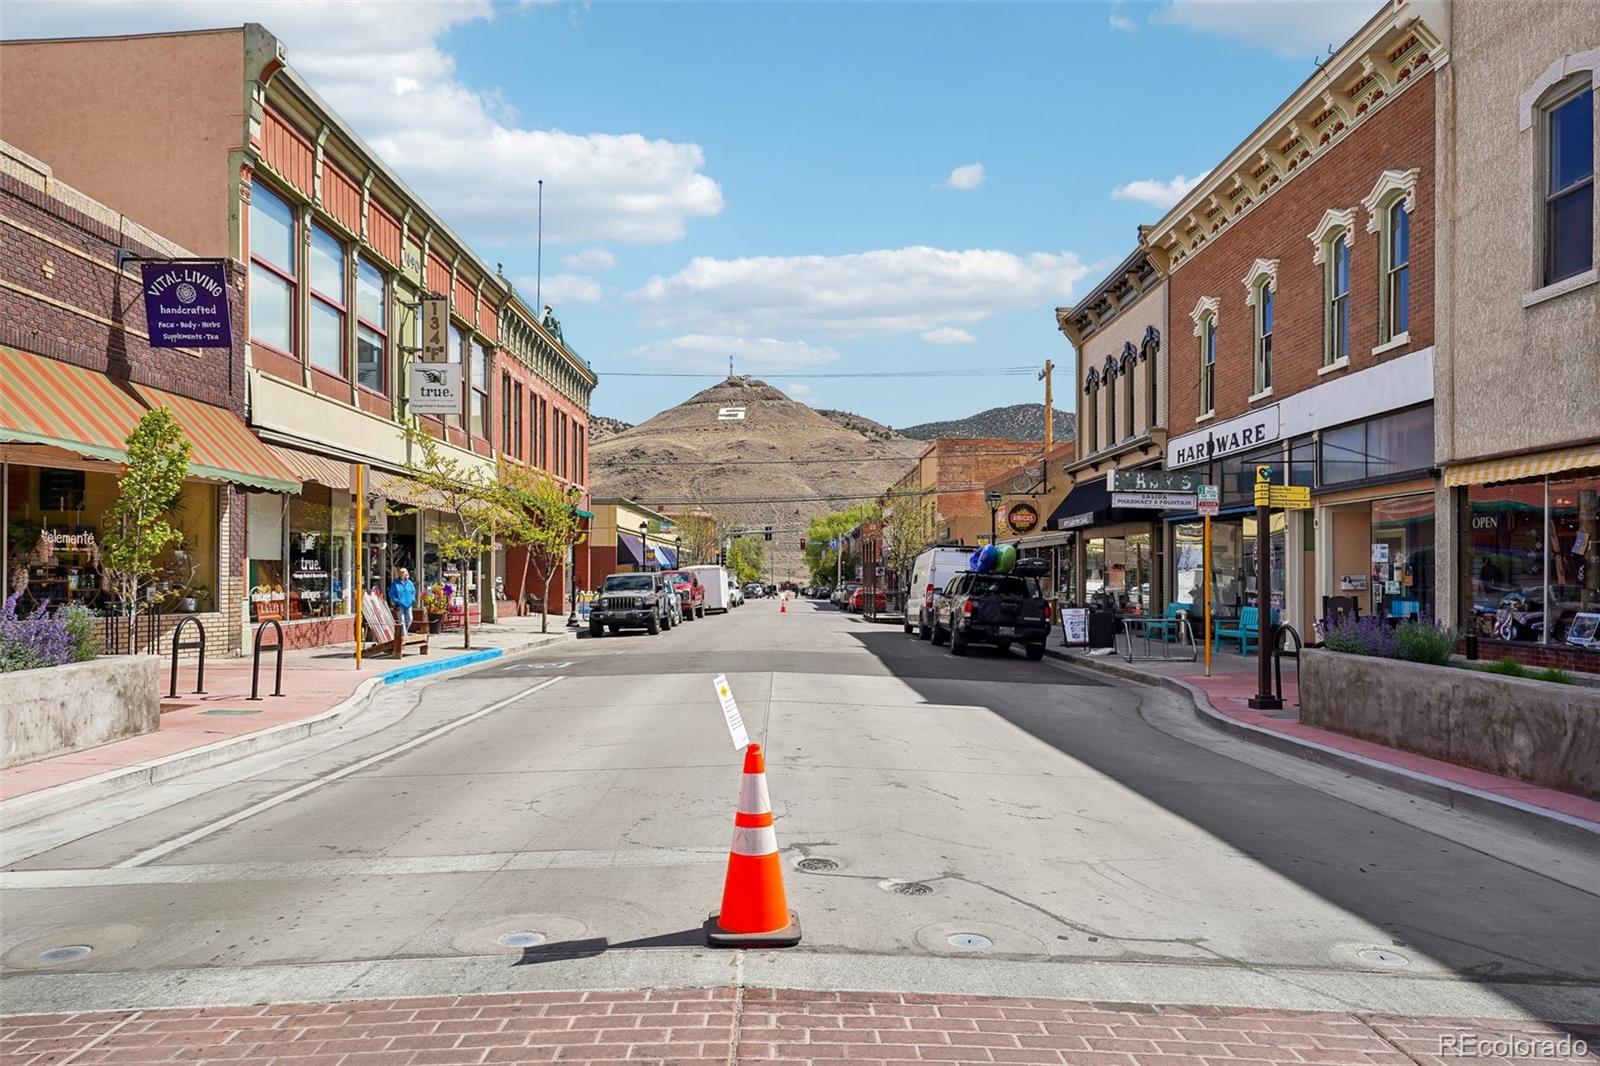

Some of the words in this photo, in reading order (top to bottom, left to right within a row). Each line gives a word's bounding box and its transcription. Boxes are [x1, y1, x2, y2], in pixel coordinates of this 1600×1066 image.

[160, 304, 217, 315] handcrafted
[158, 321, 174, 329] Face
[180, 320, 197, 330] Body
[201, 321, 221, 329] Herbs
[162, 332, 202, 343] Supplements
[420, 386, 454, 398] true.
[717, 407, 747, 420] S
[1177, 423, 1266, 464] HARDWARE
[1472, 516, 1498, 529] OPEN
